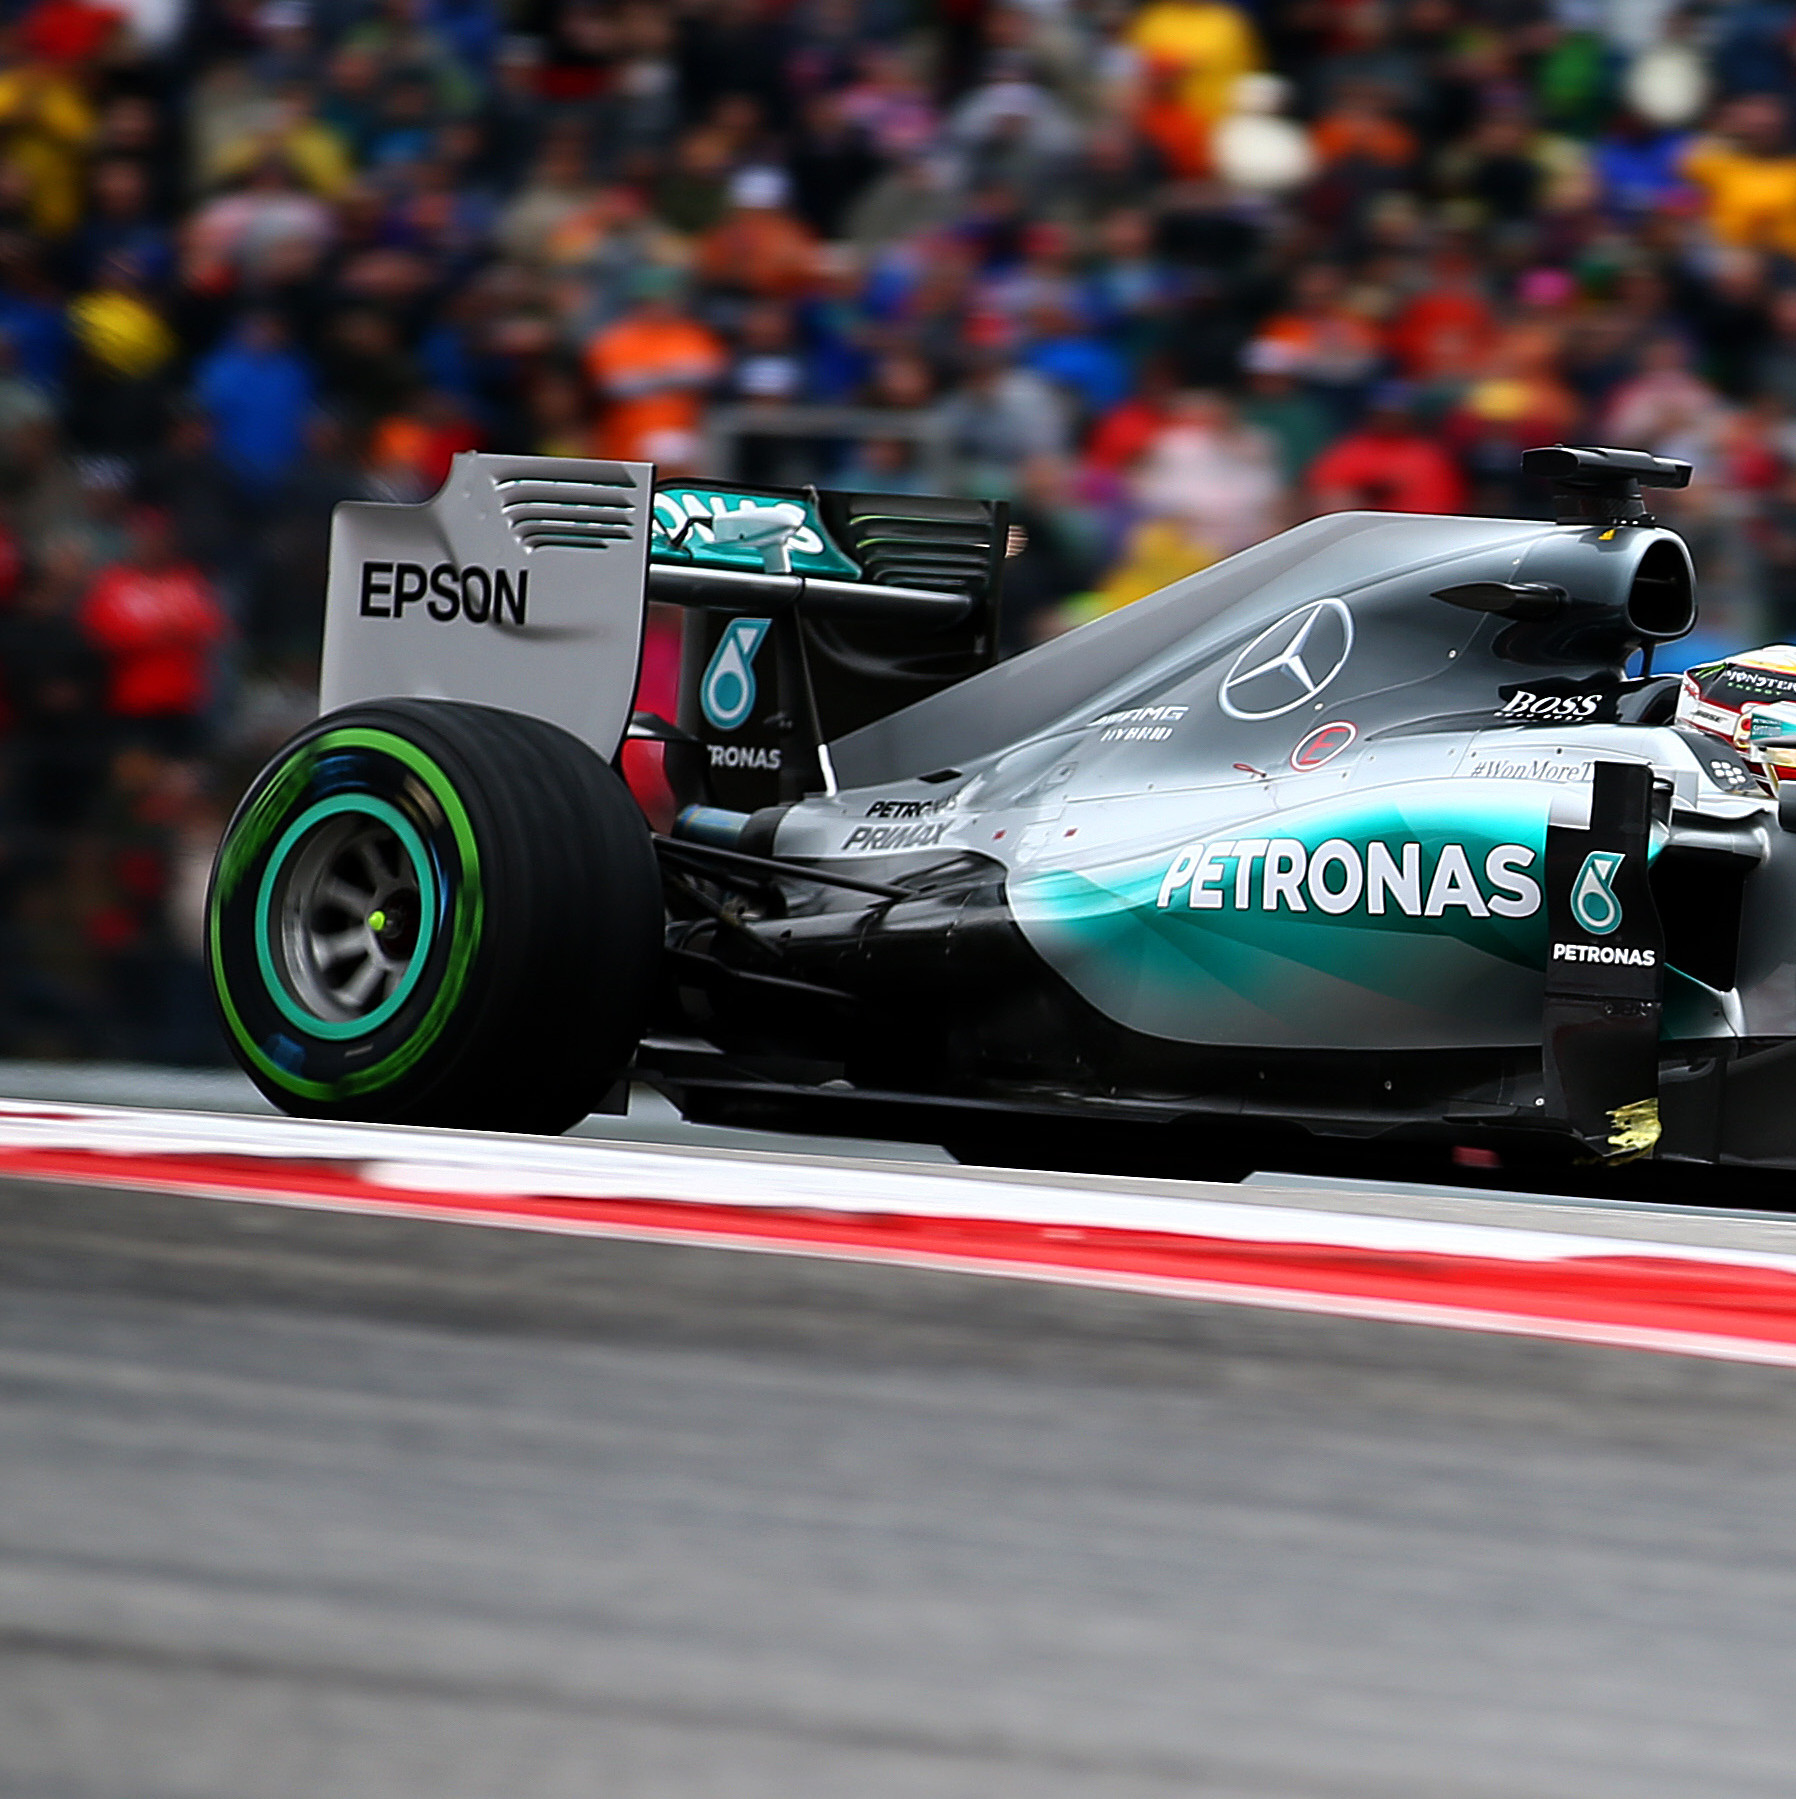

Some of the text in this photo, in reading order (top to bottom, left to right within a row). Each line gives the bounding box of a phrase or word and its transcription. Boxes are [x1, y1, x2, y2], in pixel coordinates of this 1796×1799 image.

[359, 561, 530, 626] EPSON
[1120, 706, 1190, 722] AMG
[1501, 689, 1603, 716] BOSS
[1100, 726, 1174, 742] HYBRID
[841, 820, 955, 850] PRIMAX
[1156, 837, 1542, 919] PETRONAS
[1552, 943, 1656, 967] PETRONAS
